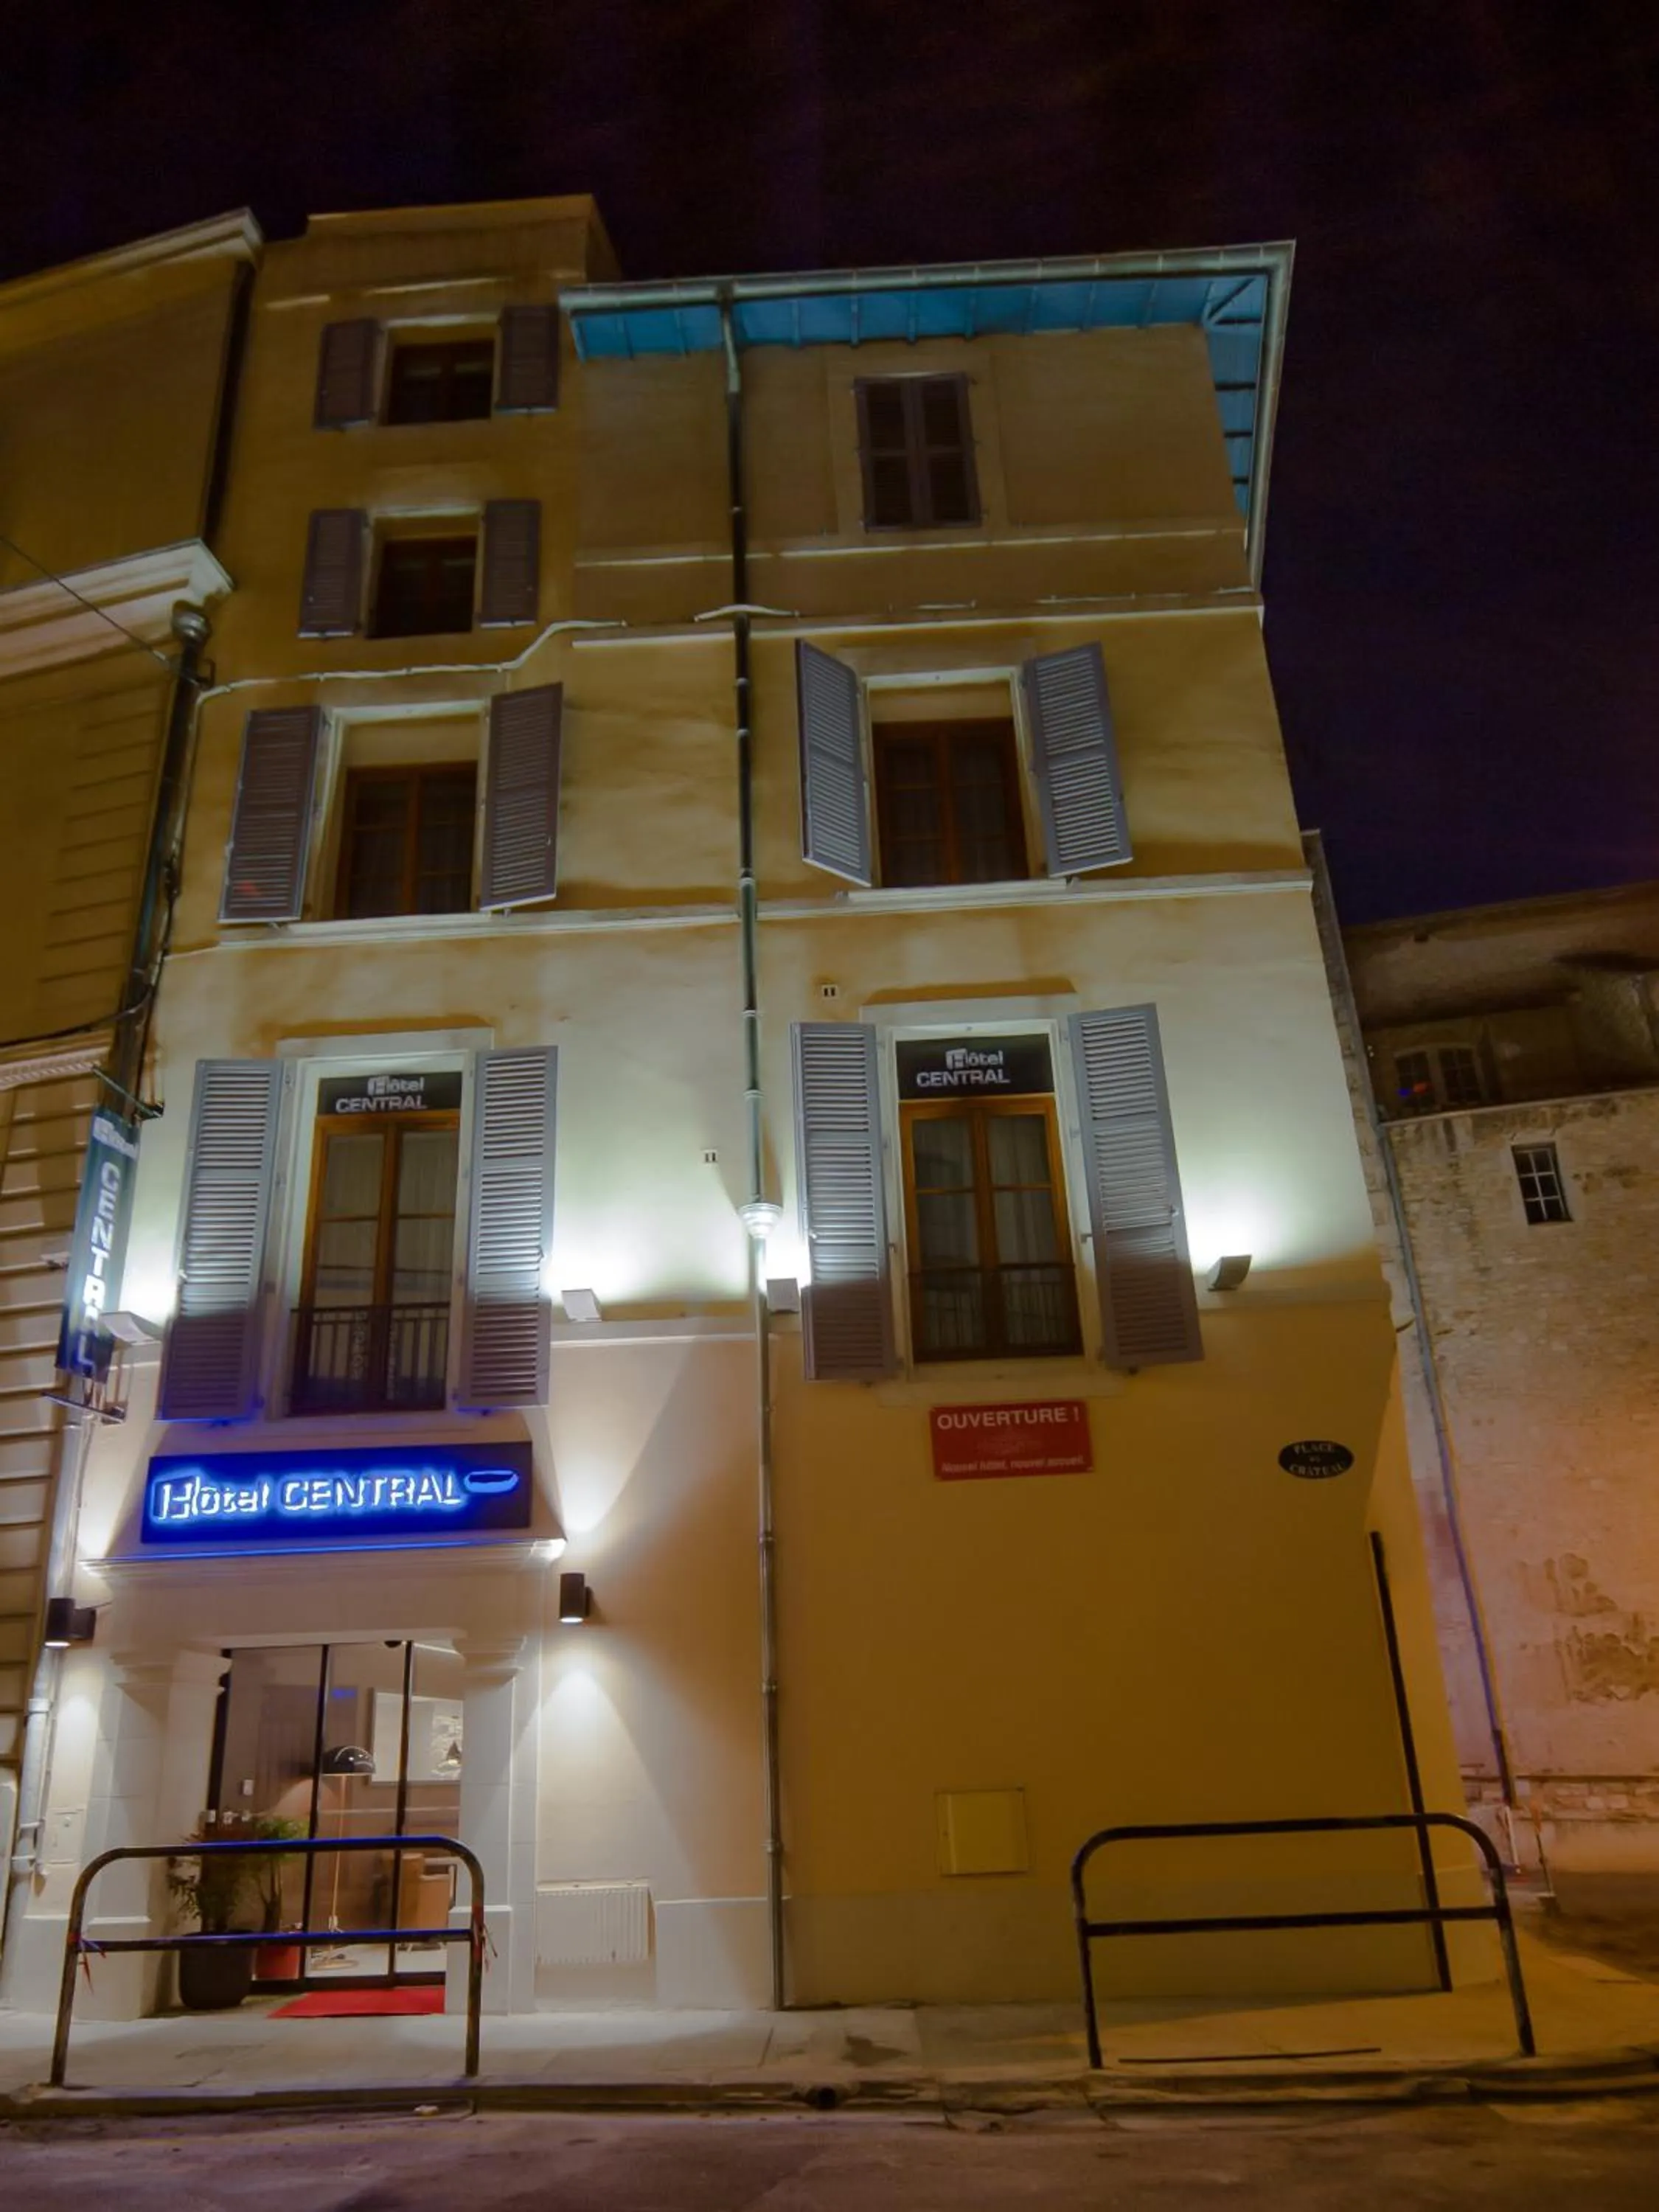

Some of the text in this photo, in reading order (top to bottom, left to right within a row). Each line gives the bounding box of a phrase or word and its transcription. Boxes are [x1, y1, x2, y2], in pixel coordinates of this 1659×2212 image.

[945, 1048, 1004, 1069] Hôtel
[367, 1074, 425, 1096] Hôtel
[917, 1069, 1011, 1087] CENTRAL
[335, 1095, 428, 1113] CENTRAL
[77, 1161, 121, 1366] CENTRAL
[937, 1407, 1068, 1430] OUVERTURE
[281, 1473, 462, 1511] CENTRAL
